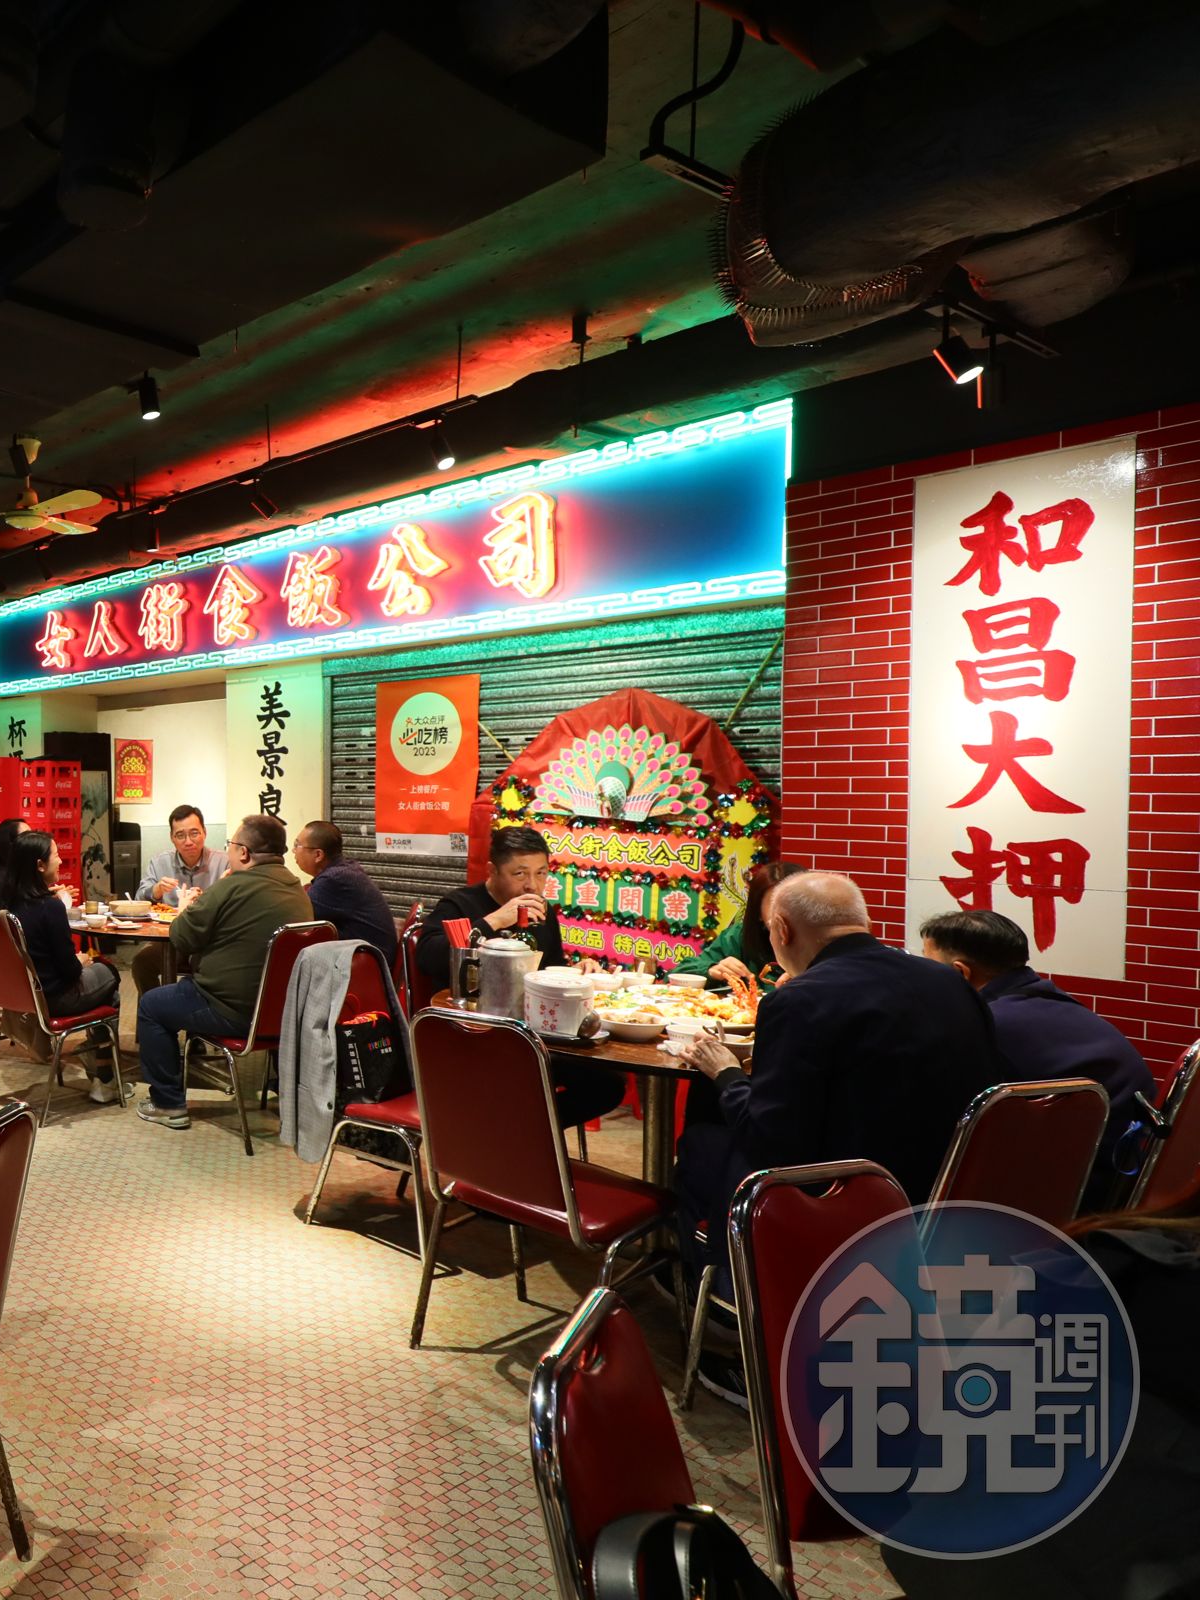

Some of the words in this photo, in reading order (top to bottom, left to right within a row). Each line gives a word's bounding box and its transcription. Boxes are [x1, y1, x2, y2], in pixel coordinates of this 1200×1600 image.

[35, 490, 560, 669] 女人街食飯公司
[413, 747, 437, 757] 2023
[942, 490, 1096, 953] 和昌大押
[543, 830, 702, 872] 女人街食飯公司
